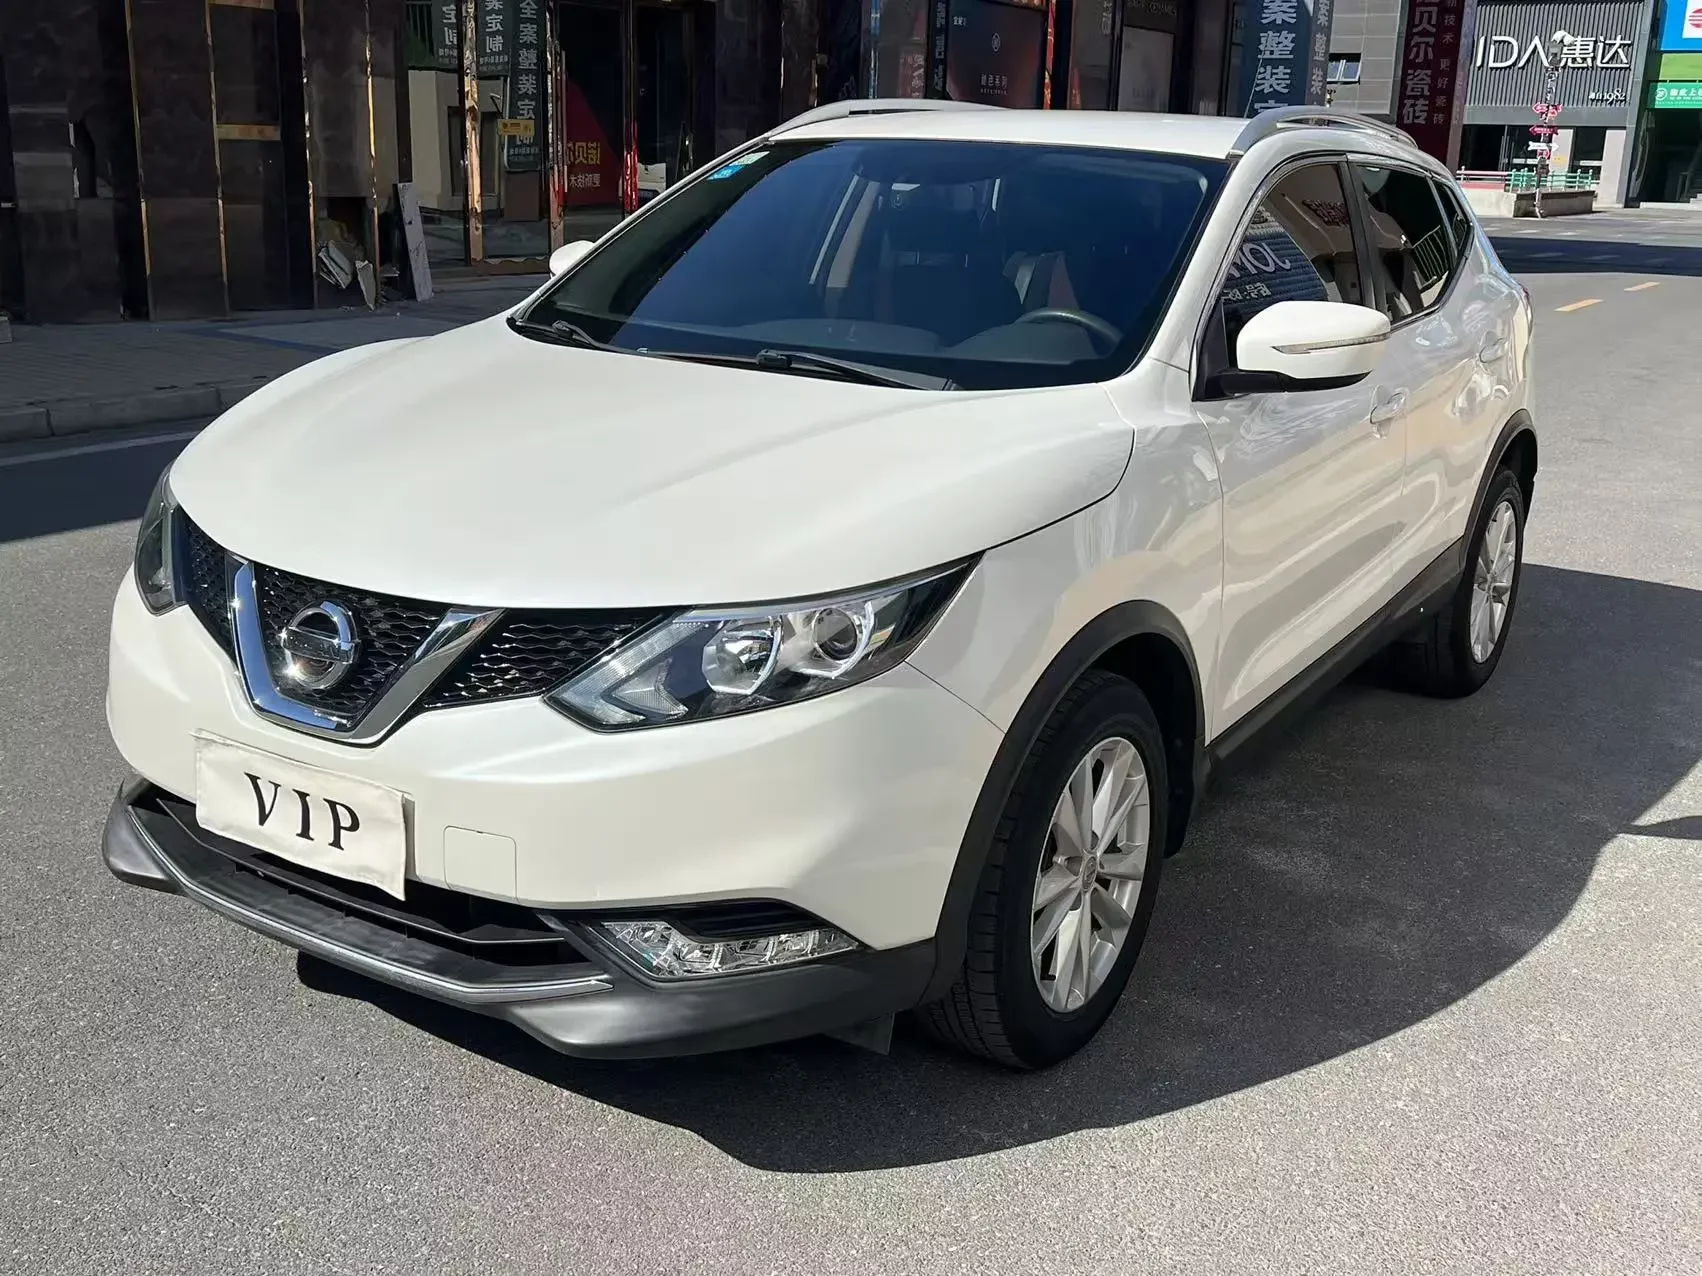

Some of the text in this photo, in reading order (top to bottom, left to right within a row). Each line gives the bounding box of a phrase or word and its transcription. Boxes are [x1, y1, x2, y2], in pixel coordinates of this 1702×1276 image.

[1403, 0, 1438, 125] 贝尔瓷砖
[1560, 34, 1632, 68] 惠达
[244, 771, 361, 851] VIP
